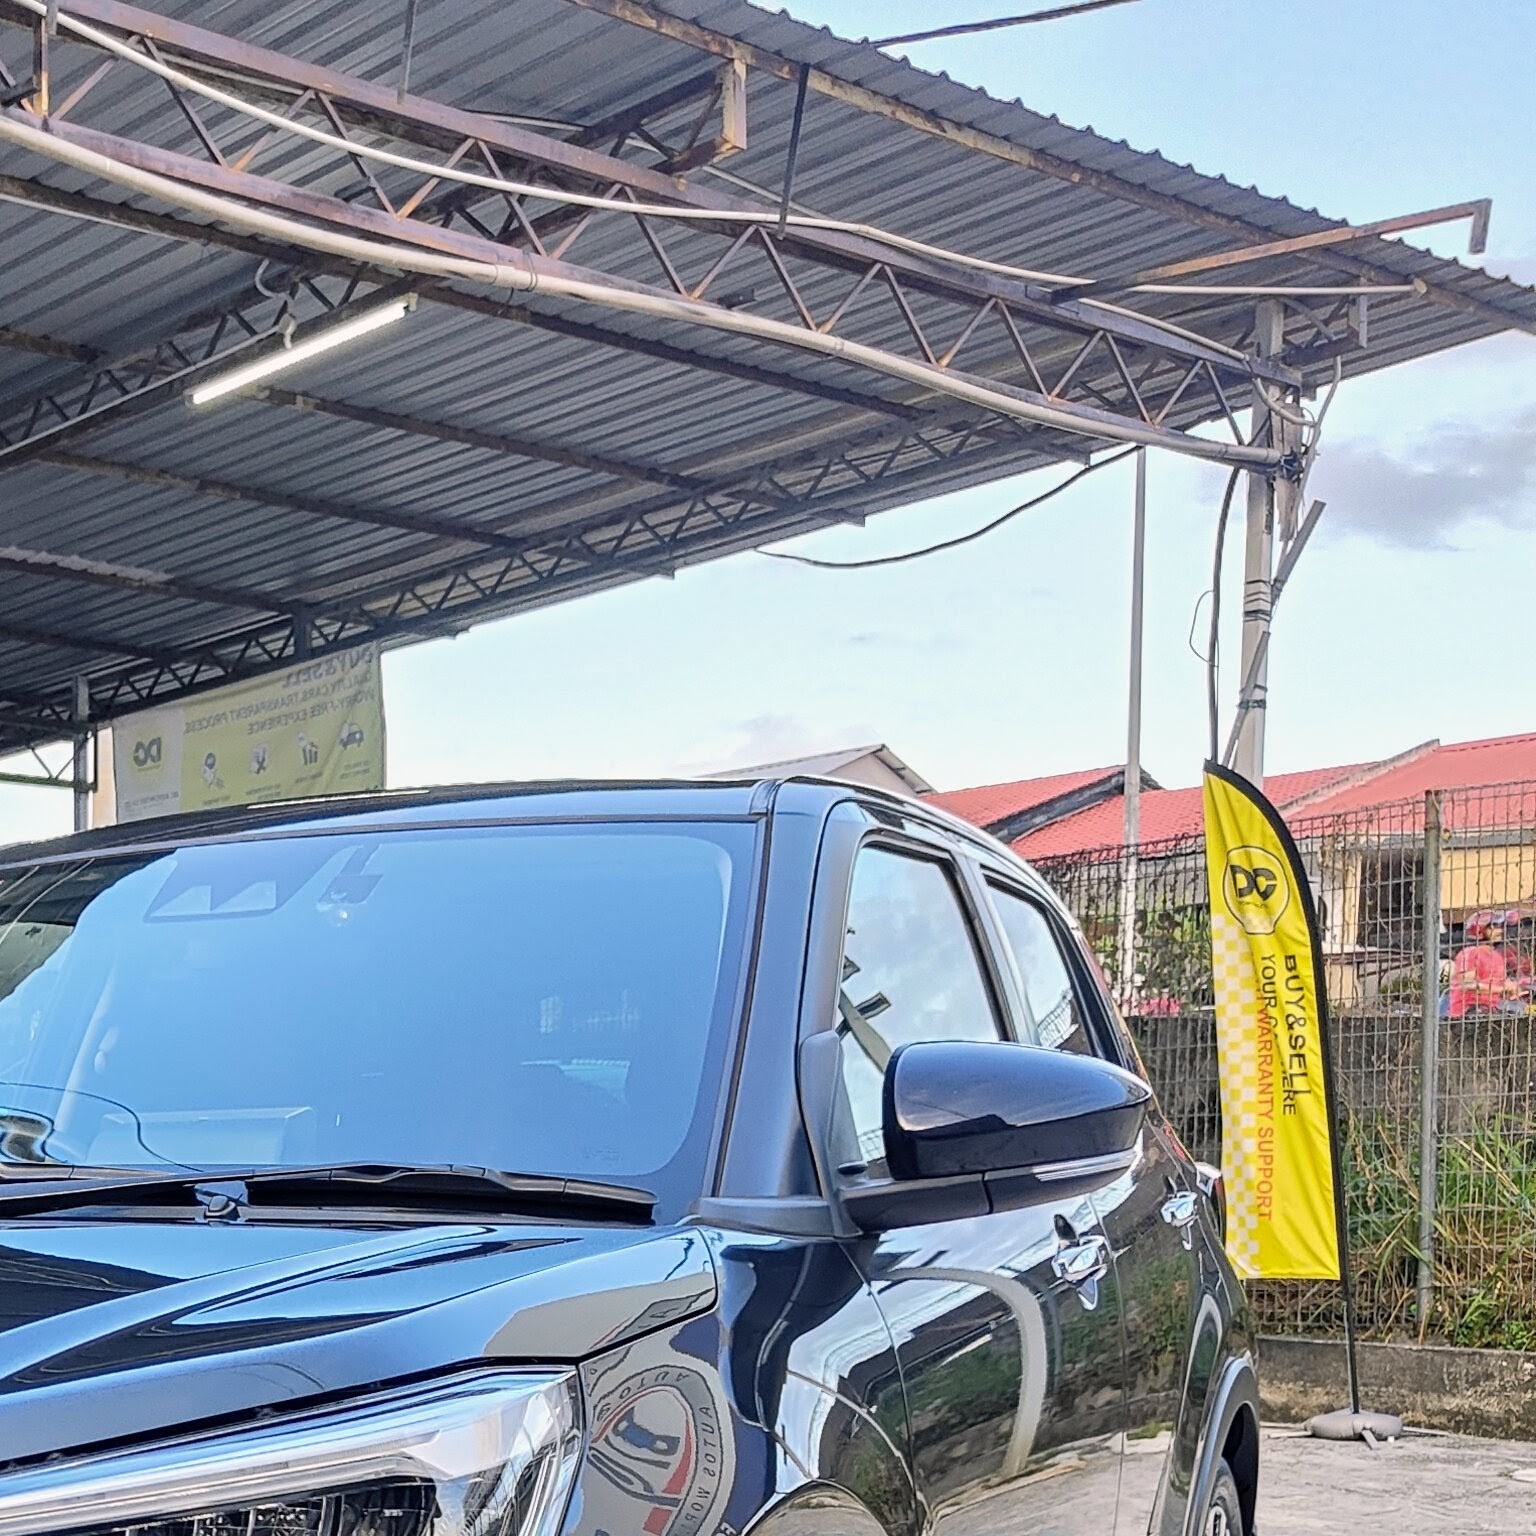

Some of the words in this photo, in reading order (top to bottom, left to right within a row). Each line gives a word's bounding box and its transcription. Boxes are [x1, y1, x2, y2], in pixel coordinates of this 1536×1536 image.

[1229, 864, 1278, 902] DC
[1261, 953, 1278, 1009] YOUR
[1256, 1006, 1275, 1121] WARRANTY
[1256, 1126, 1275, 1221] SUPPORT
